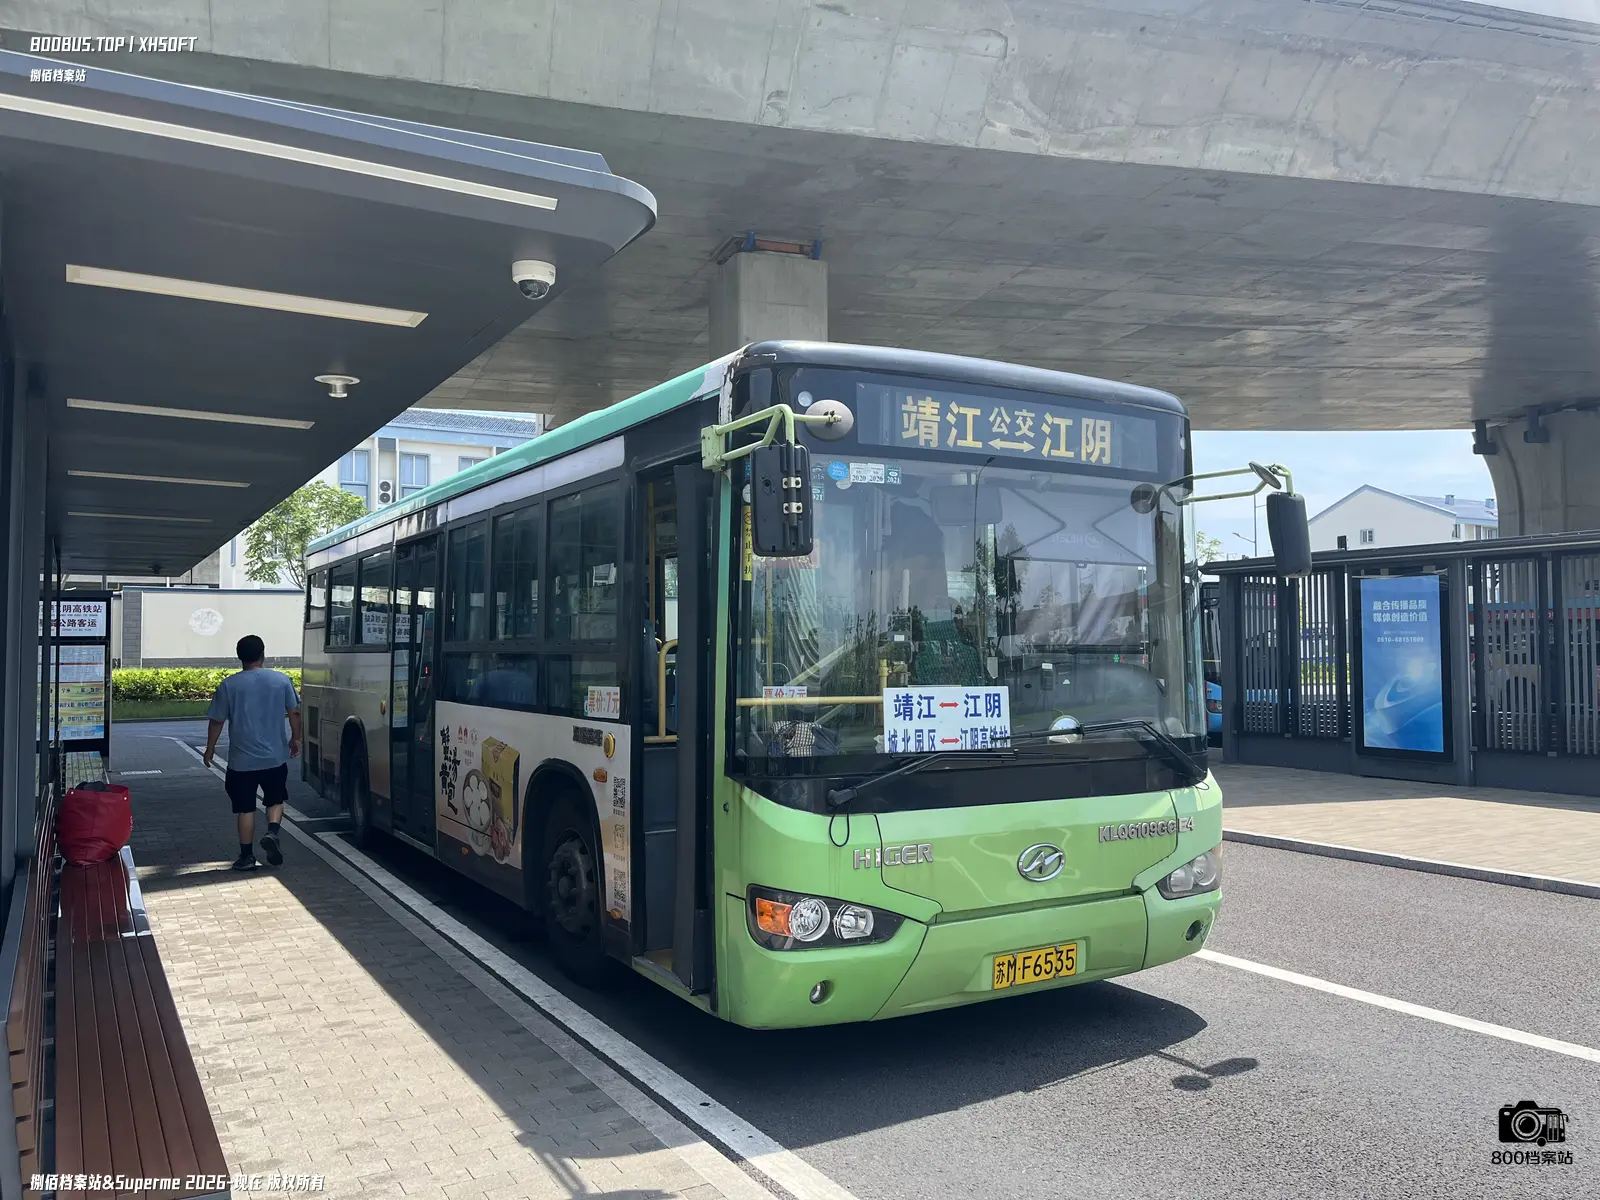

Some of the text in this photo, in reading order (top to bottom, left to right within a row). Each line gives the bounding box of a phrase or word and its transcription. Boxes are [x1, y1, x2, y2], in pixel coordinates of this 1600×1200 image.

[901, 395, 1111, 465] 靖江 公交 江阴
[894, 692, 1002, 721] 靖江 江阴
[887, 728, 936, 753] 城北园区
[853, 843, 934, 870] HIGER
